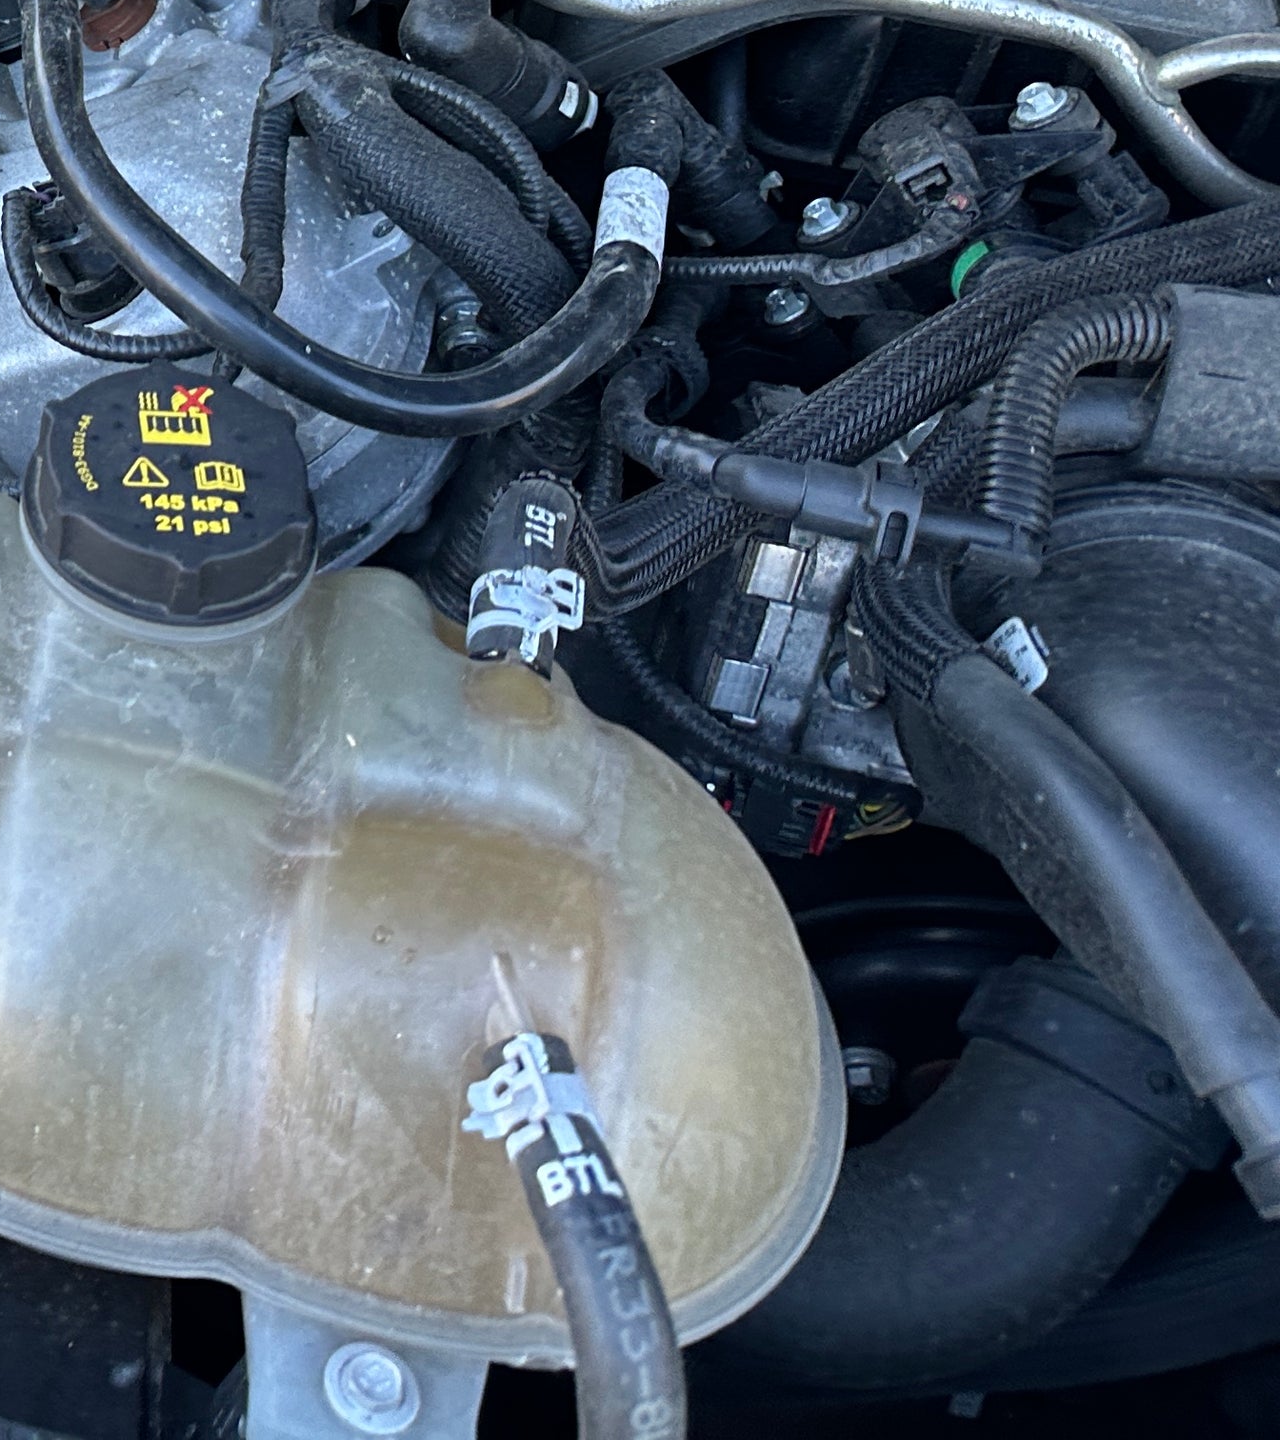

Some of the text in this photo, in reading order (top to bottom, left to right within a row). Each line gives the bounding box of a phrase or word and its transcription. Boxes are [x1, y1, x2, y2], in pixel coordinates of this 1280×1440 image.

[140, 493, 239, 514] 145 kPa
[154, 514, 231, 536] 21 psi
[537, 1154, 623, 1207] BTL
